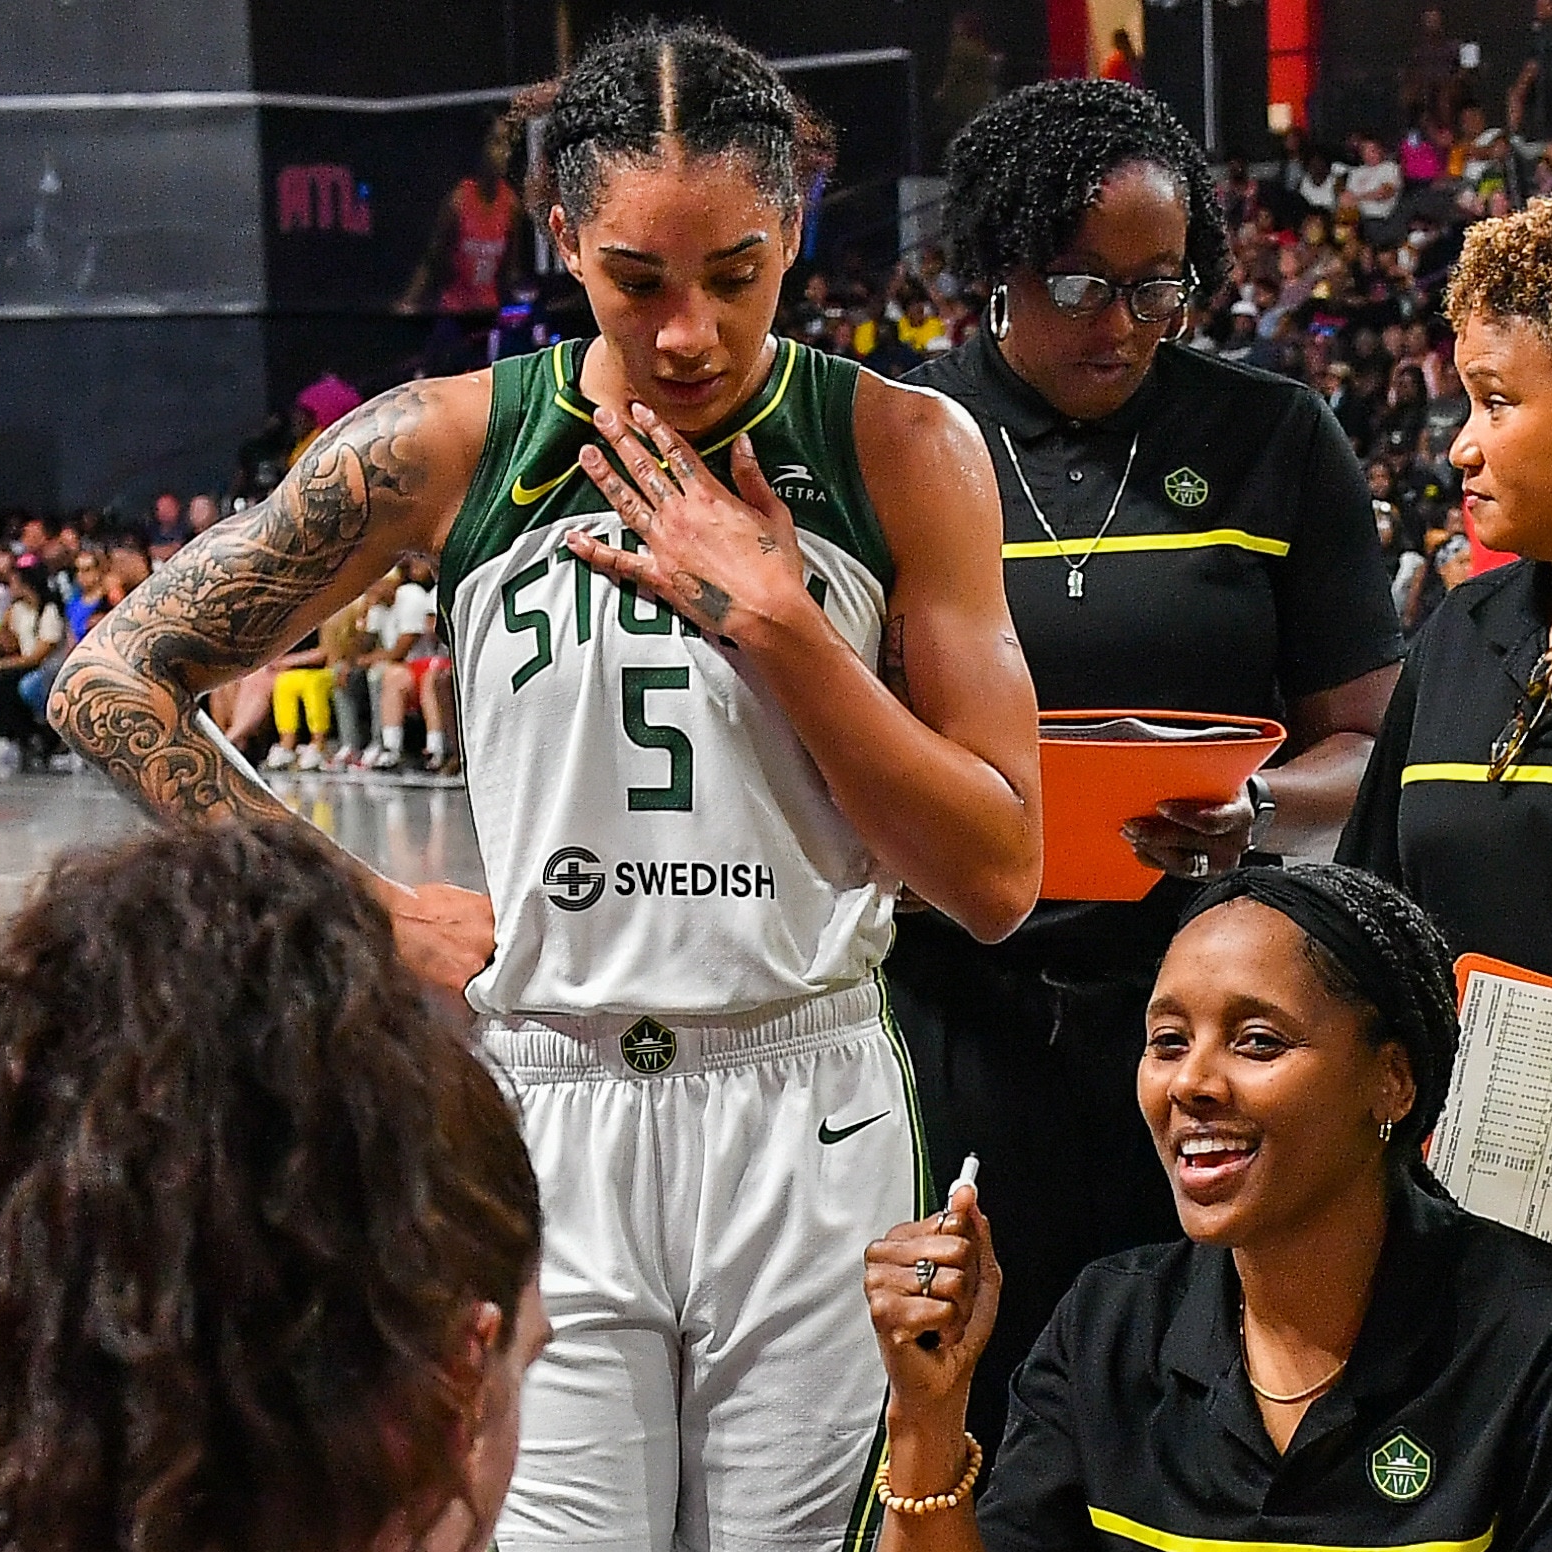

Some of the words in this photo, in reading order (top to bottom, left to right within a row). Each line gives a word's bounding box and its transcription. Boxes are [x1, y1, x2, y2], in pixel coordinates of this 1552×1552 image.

[772, 486, 827, 502] METRA
[621, 666, 694, 812] 5
[614, 862, 776, 899] SWEDISH
